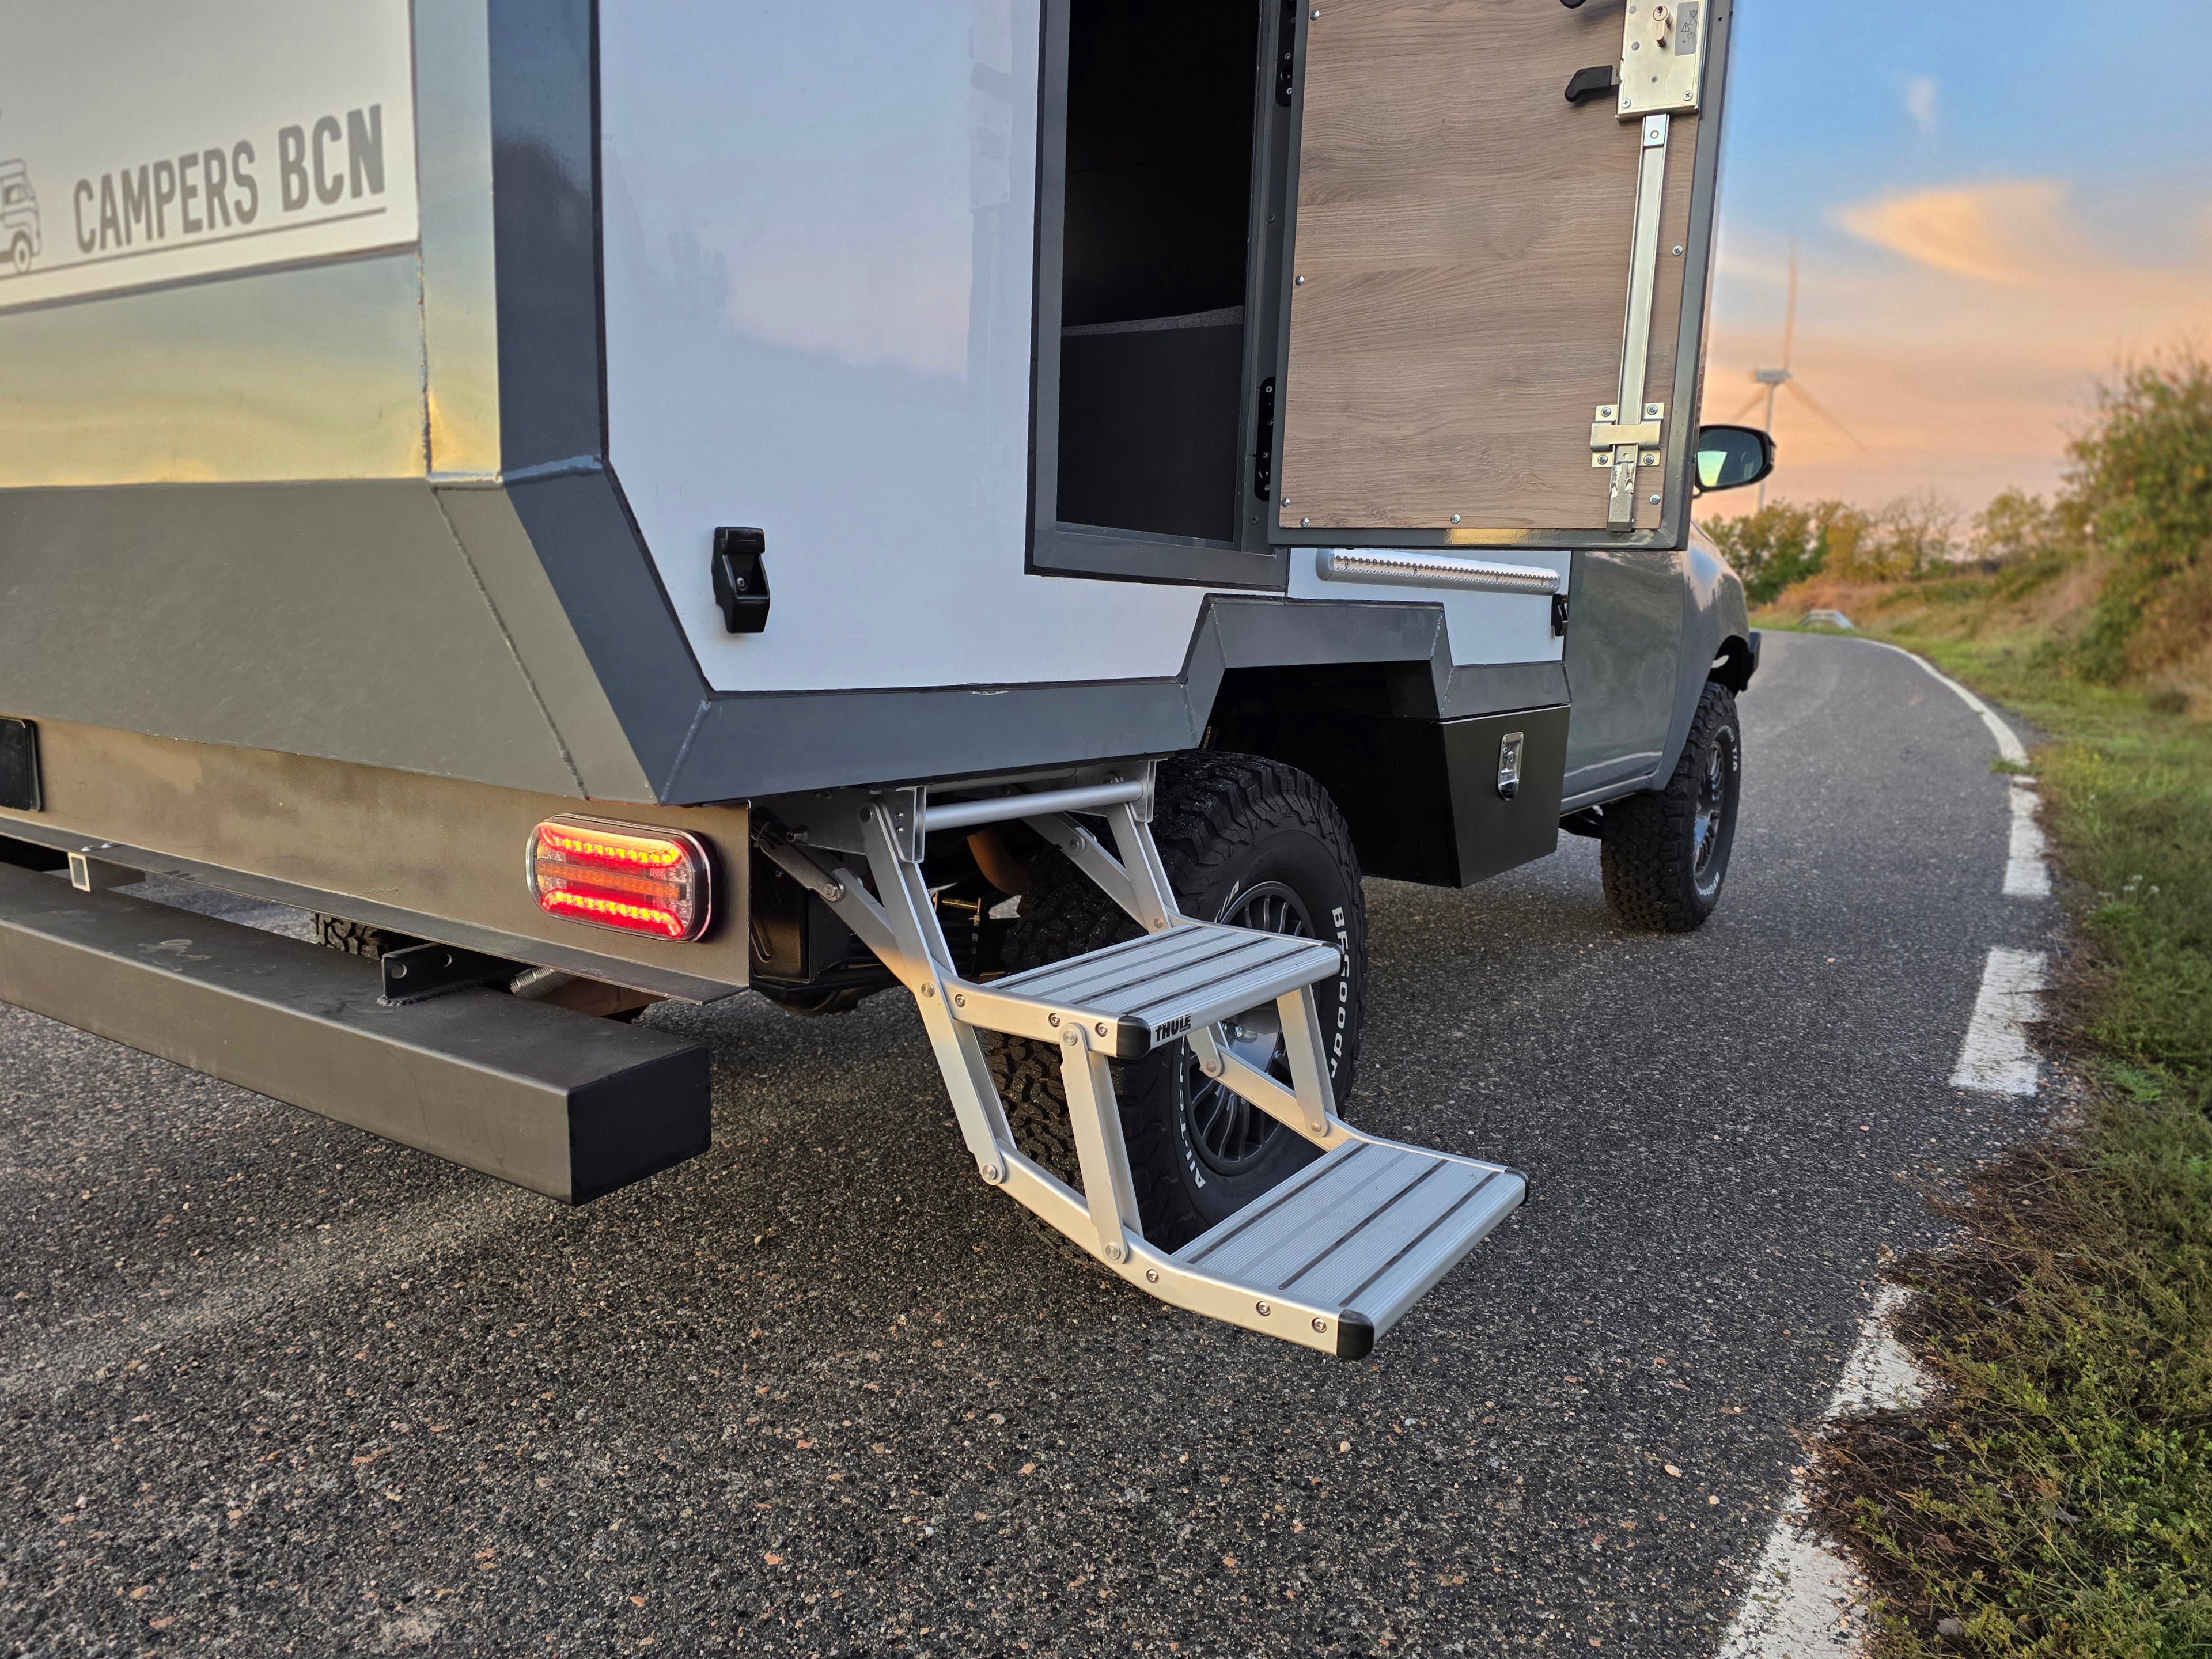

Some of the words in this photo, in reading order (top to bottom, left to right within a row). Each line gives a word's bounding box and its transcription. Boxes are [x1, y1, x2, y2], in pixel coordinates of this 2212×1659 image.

[73, 139, 259, 254] CAMPERS
[278, 103, 385, 212] BCN
[1155, 1013, 1192, 1042] THULE
[1330, 907, 1350, 1078] BFGoodr
[1179, 1035, 1206, 1189] All-Terr
